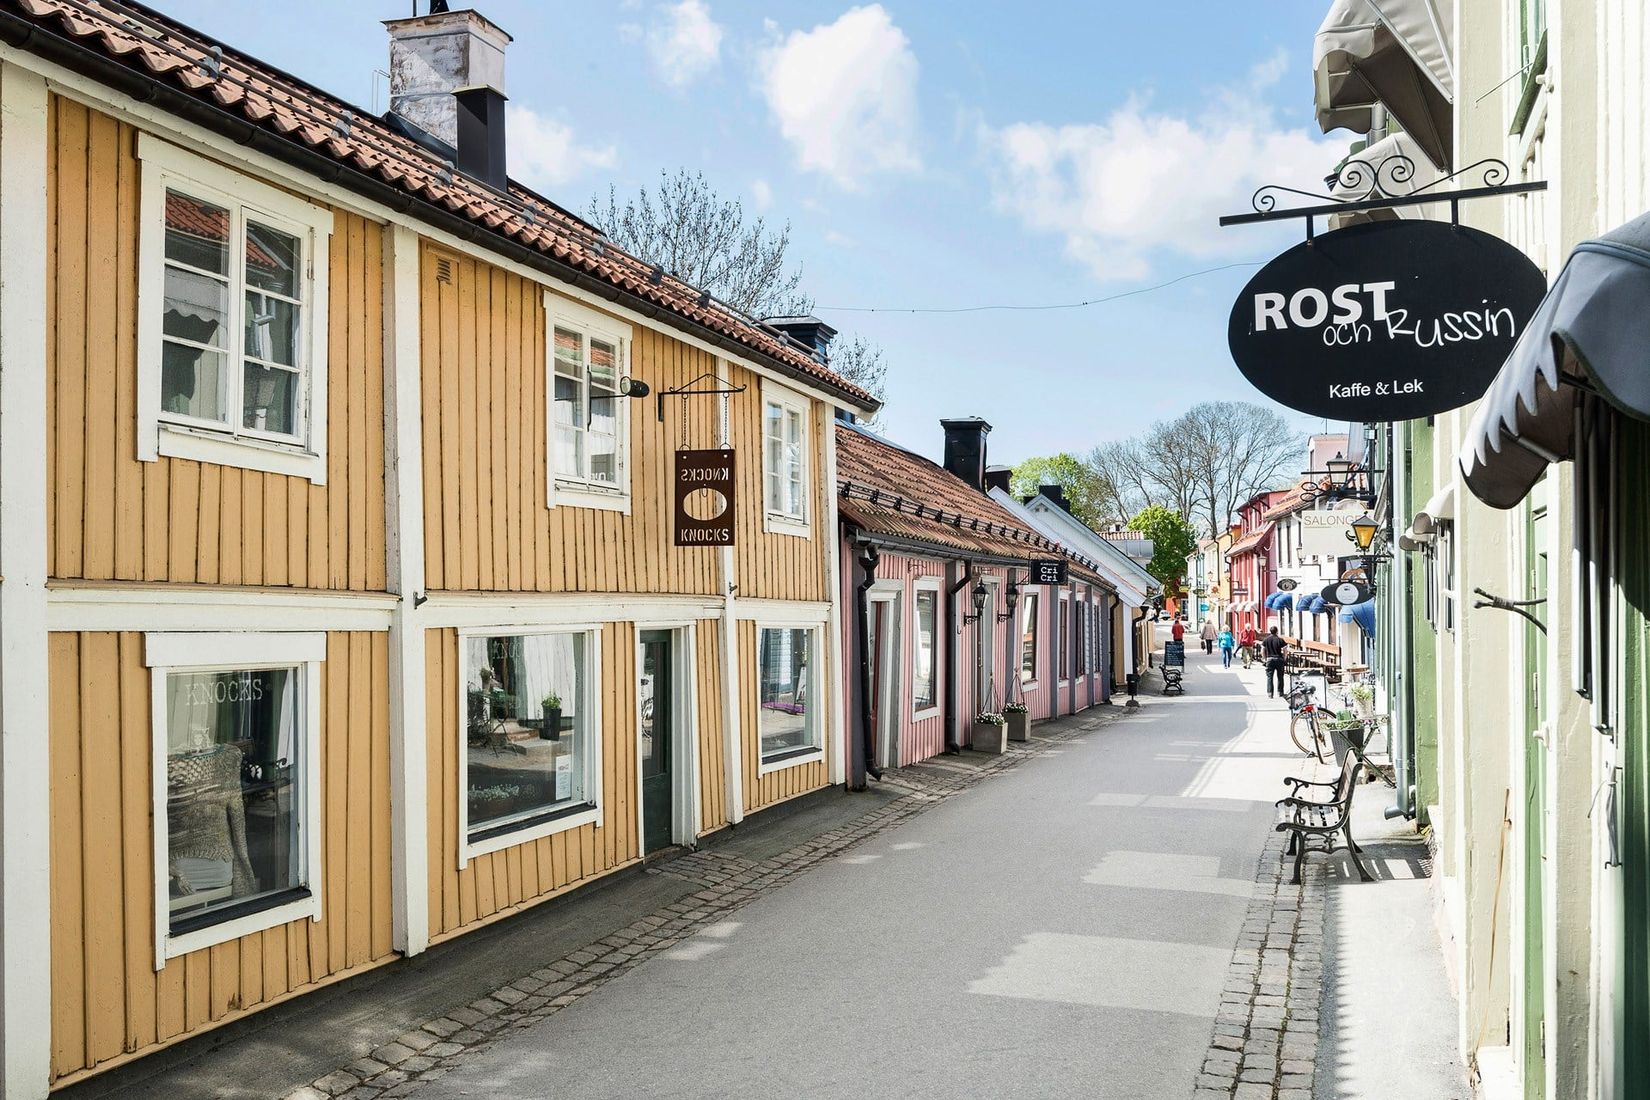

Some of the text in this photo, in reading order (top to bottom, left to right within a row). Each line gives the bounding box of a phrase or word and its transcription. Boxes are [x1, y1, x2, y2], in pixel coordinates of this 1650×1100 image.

[1254, 280, 1396, 332] ROST
[1323, 299, 1516, 347] och Russin
[1329, 378, 1424, 399] Kaffe & Lek
[680, 528, 730, 542] KNOCKS
[1040, 566, 1059, 574] Cri
[1040, 574, 1059, 582] Cri
[184, 678, 263, 706] KNOCKS
